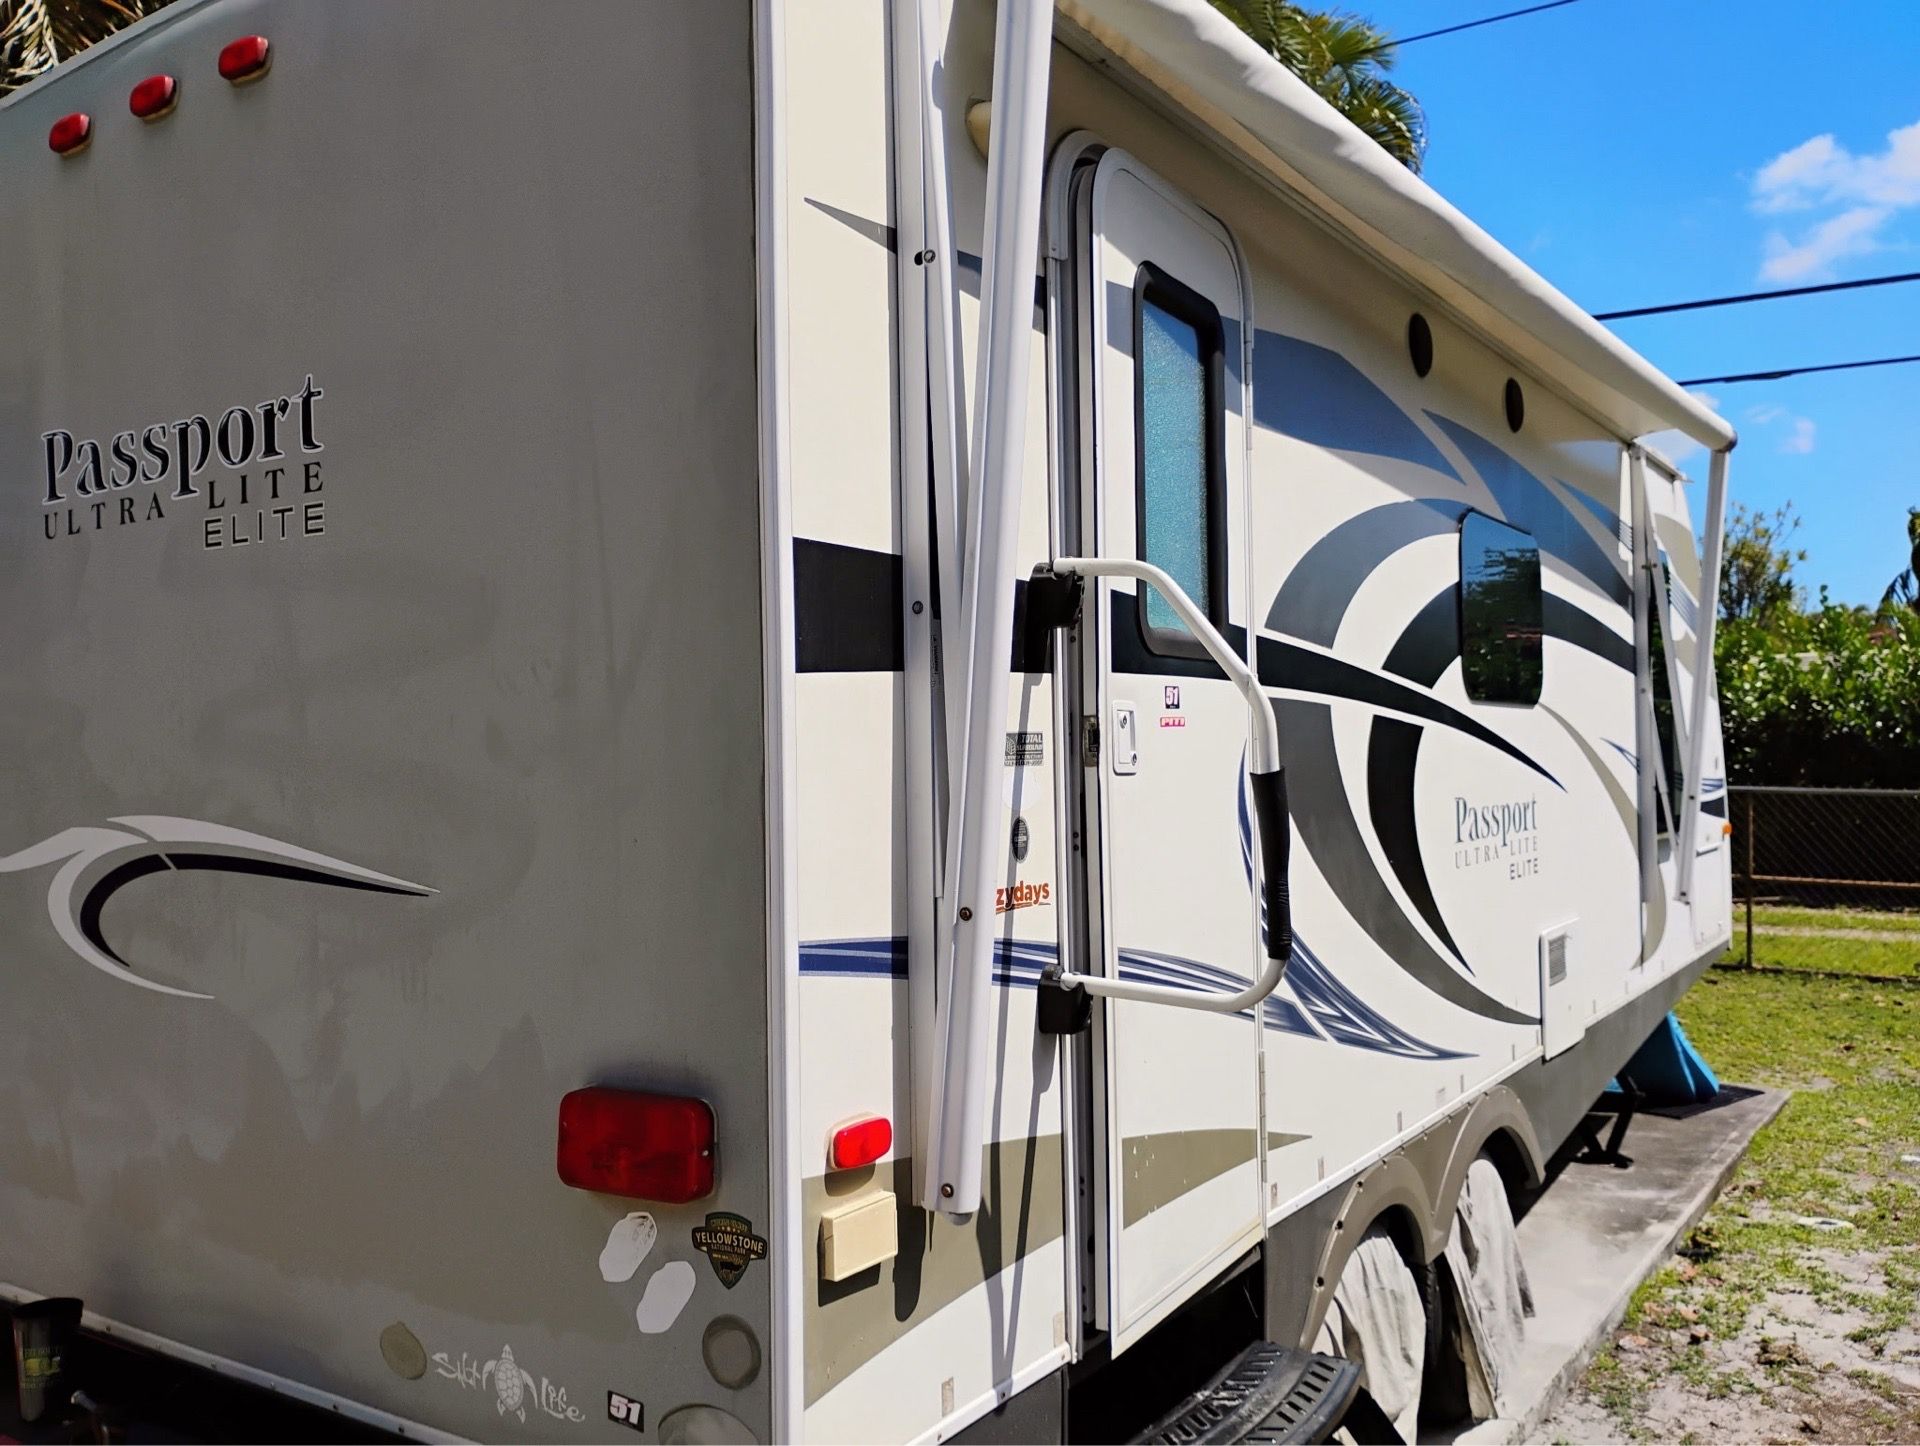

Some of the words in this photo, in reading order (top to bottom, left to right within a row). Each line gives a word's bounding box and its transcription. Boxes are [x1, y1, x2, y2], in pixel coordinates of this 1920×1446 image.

[41, 373, 324, 505] Passport
[44, 492, 166, 540] ULTRA
[207, 461, 324, 510] LITE
[204, 500, 325, 549] ELITE
[1165, 686, 1179, 705] 51
[1454, 793, 1537, 847] Passport
[1455, 843, 1500, 870] ULTRA
[1510, 836, 1538, 856] LITE
[1510, 858, 1539, 880] ELITE
[695, 1231, 764, 1254] YELLOWSTONE
[610, 1393, 641, 1425] 51
